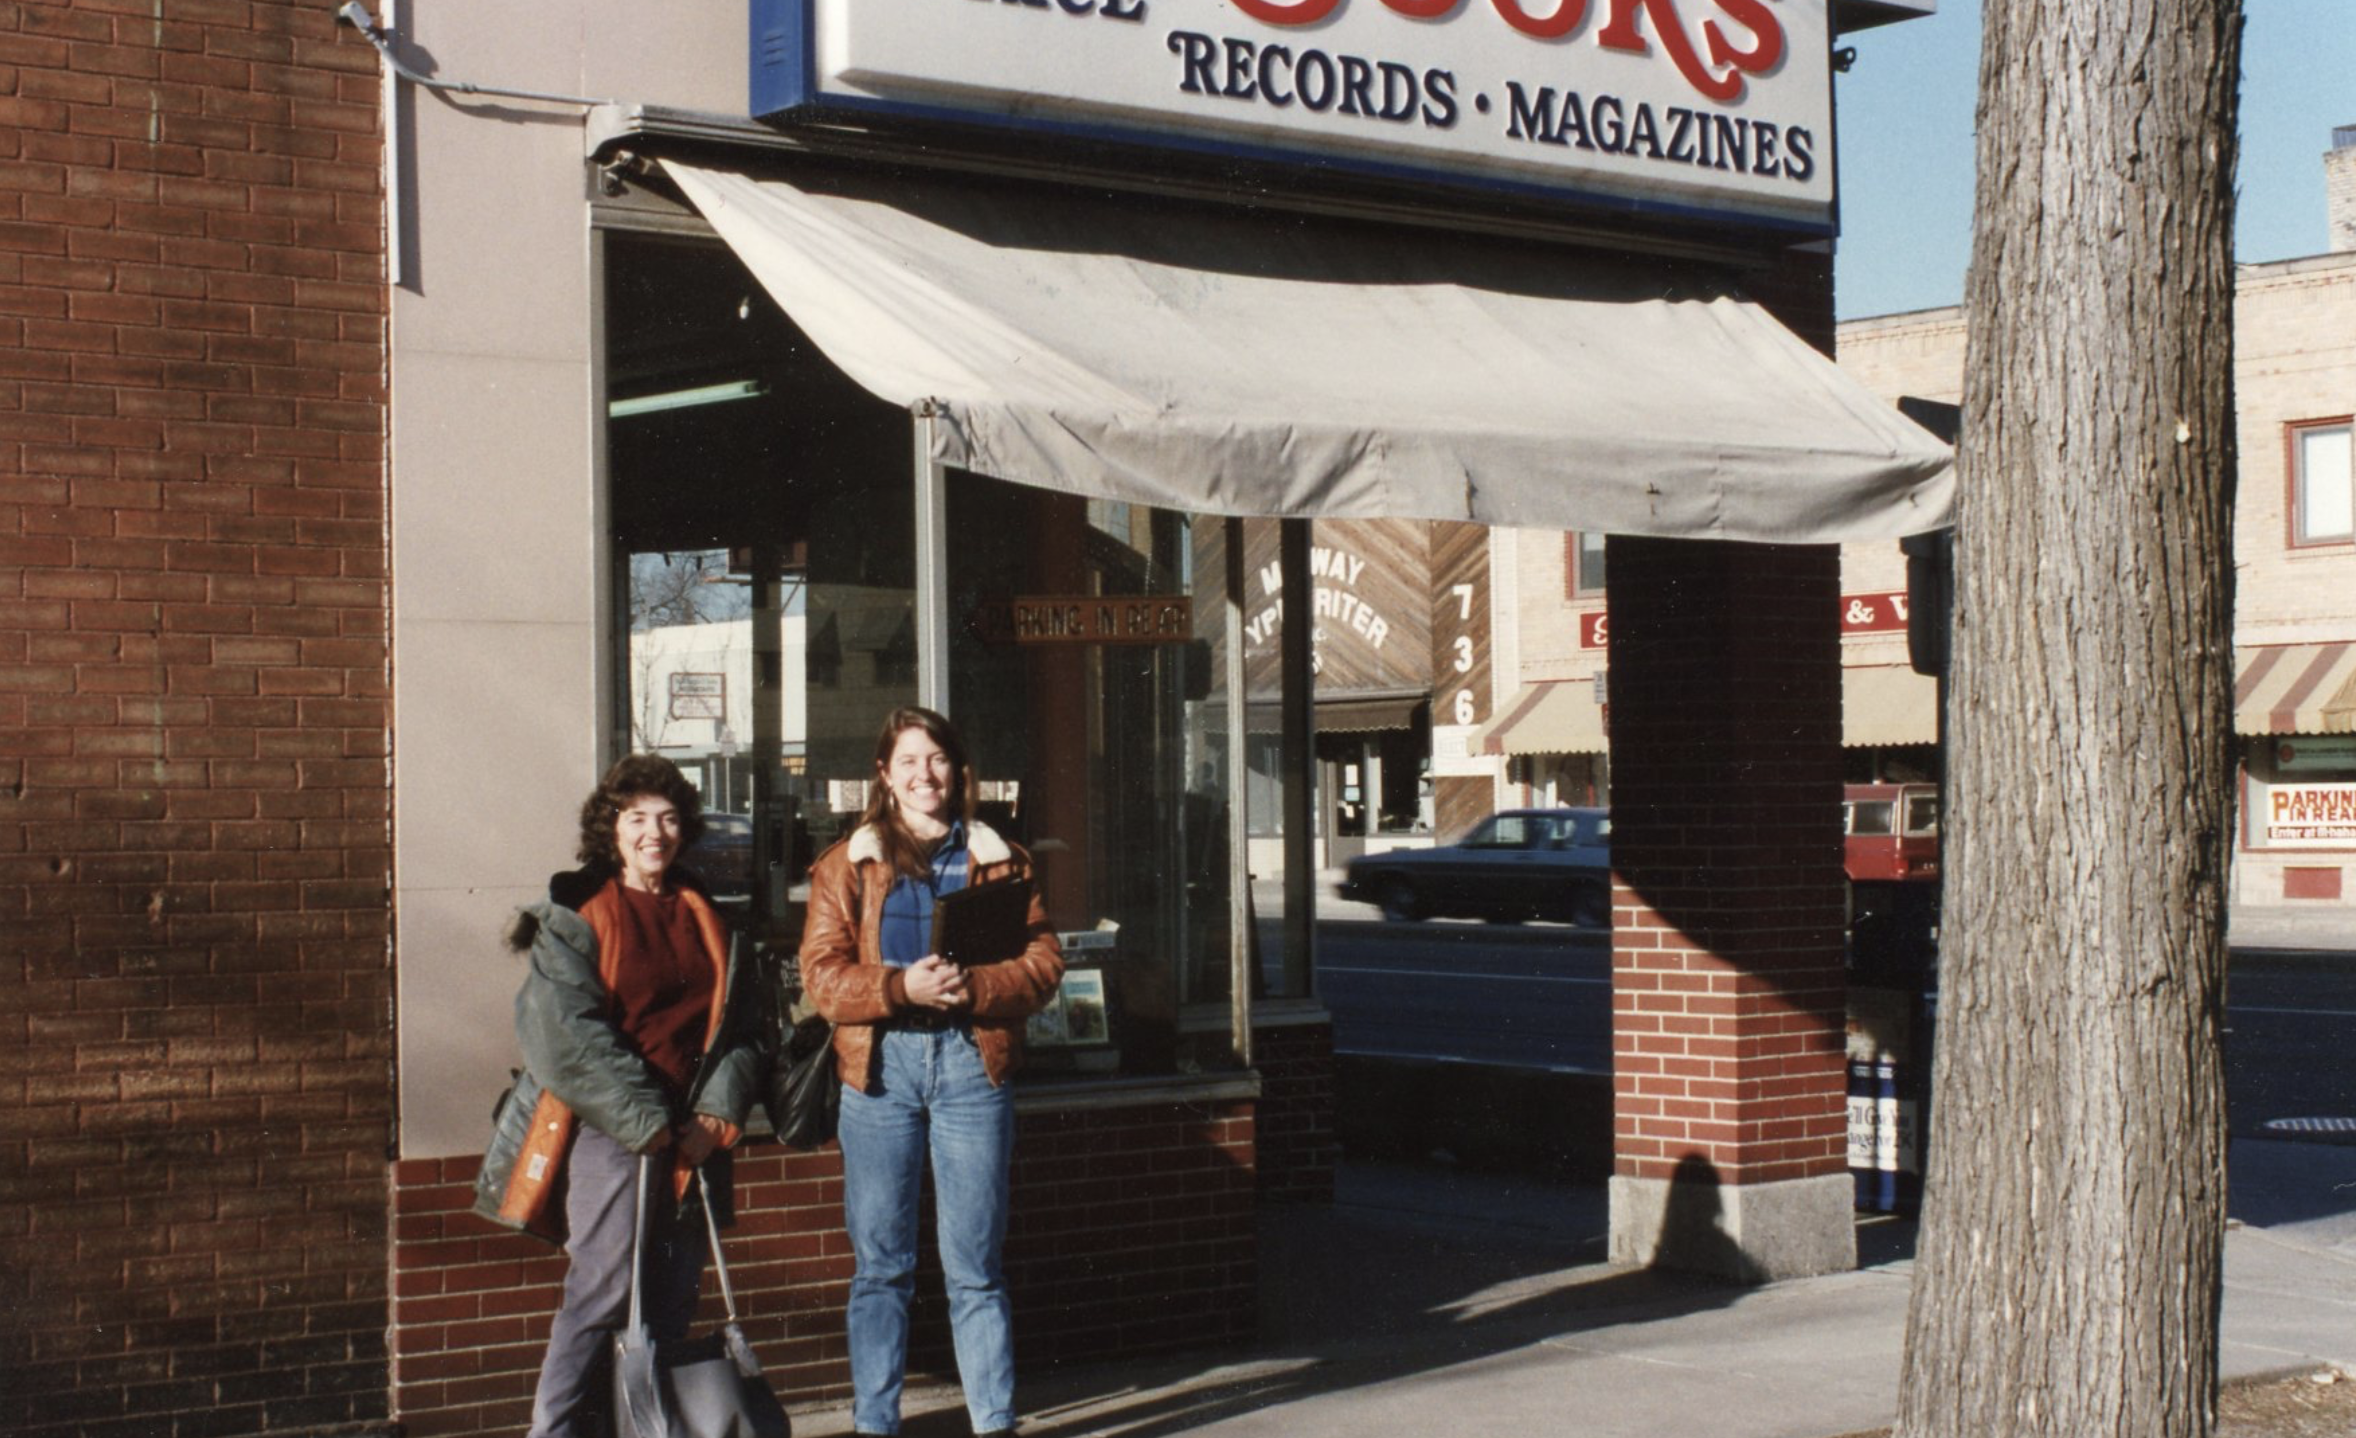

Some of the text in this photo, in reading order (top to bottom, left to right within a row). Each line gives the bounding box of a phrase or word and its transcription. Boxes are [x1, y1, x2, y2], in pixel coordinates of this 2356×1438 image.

[1167, 31, 1460, 128] RECORDS
[1505, 81, 1815, 182] MAGAZINES
[1260, 547, 1366, 596] MWAY
[2272, 790, 2356, 822] PARKIN
[2312, 807, 2356, 821] REA
